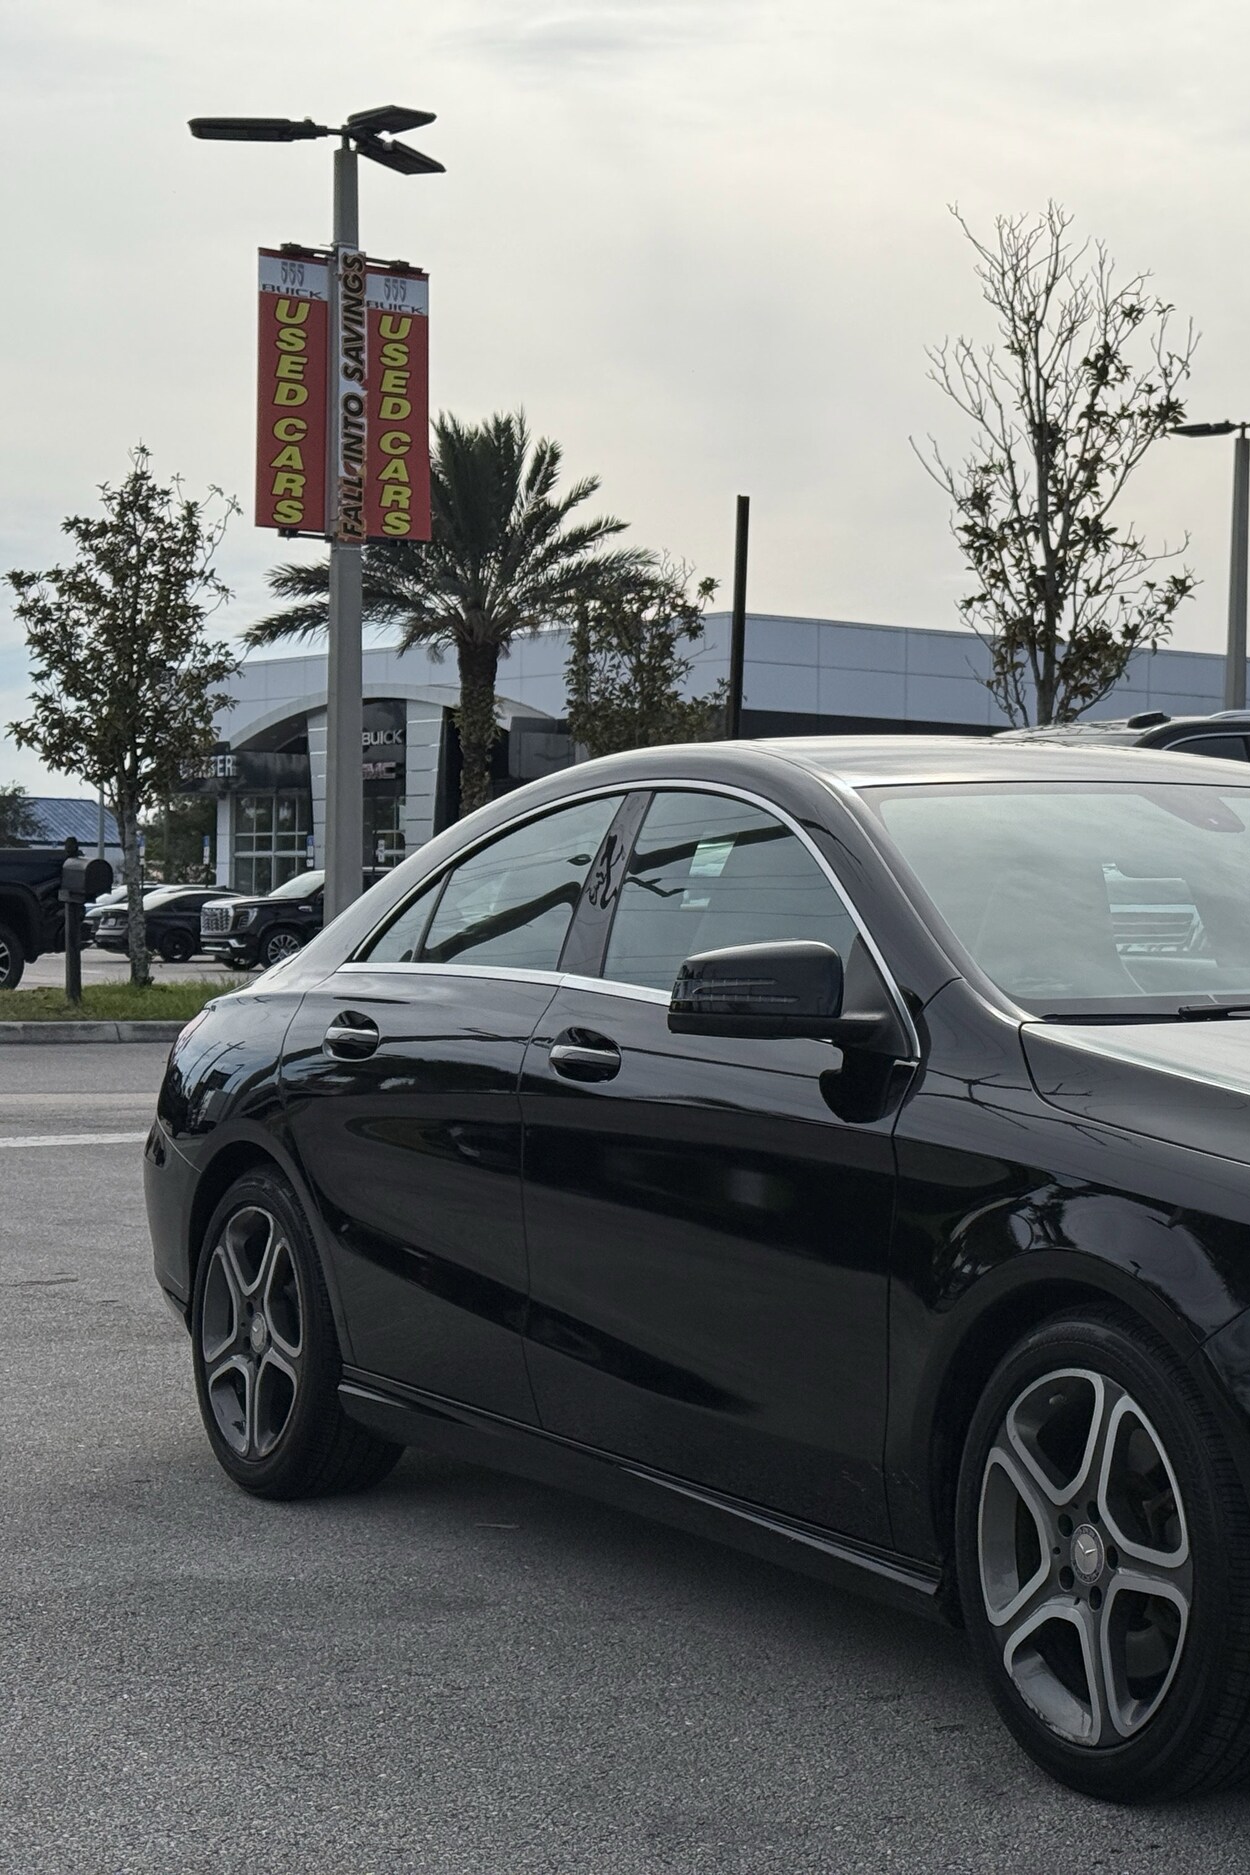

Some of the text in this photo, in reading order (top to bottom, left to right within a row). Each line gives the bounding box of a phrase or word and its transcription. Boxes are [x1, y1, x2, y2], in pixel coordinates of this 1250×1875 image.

[262, 283, 322, 299] BUICK
[366, 300, 424, 314] BUICK
[270, 298, 311, 526] USED CARS
[342, 254, 366, 537] FALL INTO SAVINGS
[377, 315, 412, 536] USED CARS
[361, 729, 403, 746] BUICK
